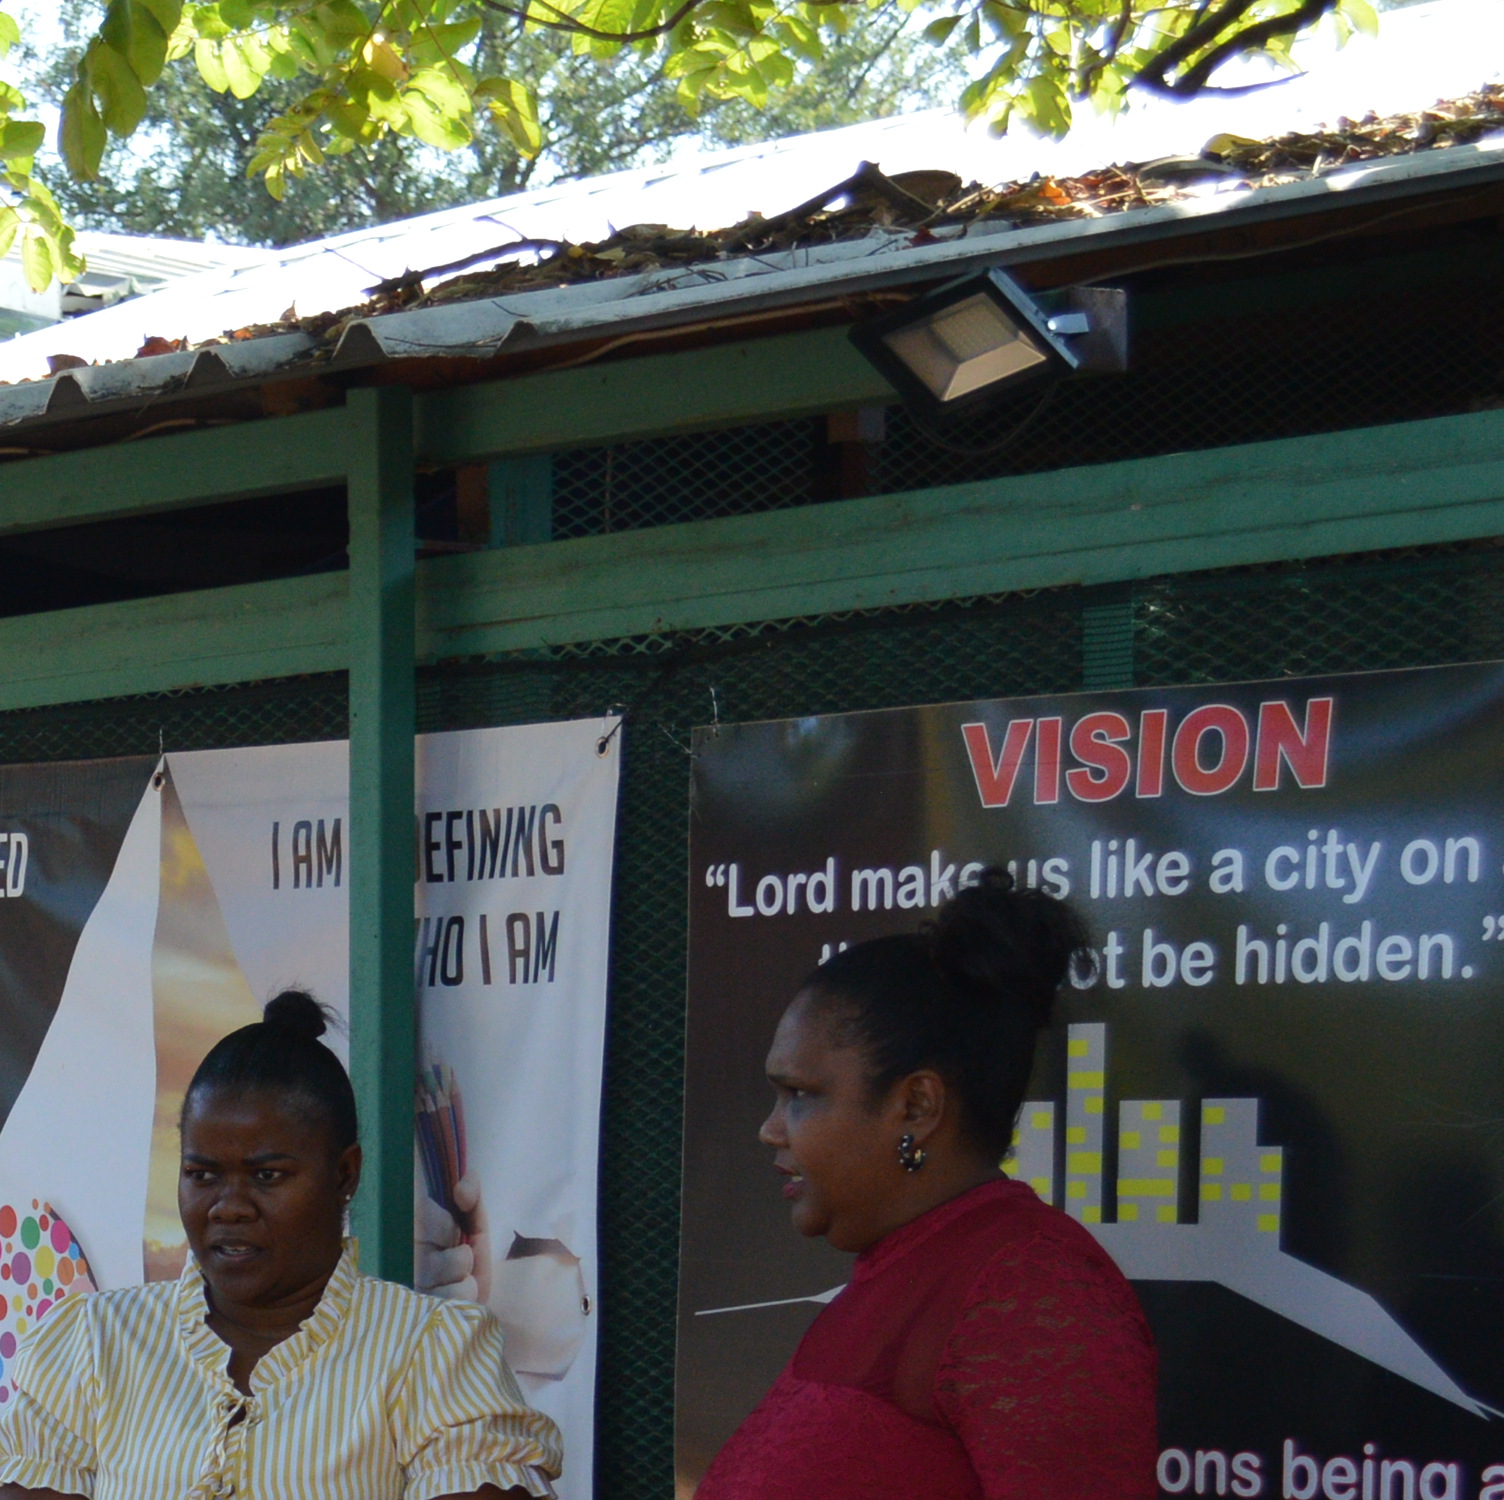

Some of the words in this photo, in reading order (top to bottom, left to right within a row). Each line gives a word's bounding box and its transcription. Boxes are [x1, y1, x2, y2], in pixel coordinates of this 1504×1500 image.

[959, 697, 1334, 809] VISION
[272, 821, 280, 890] I
[293, 817, 342, 889] AM
[705, 856, 835, 918] “Lord
[1090, 837, 1191, 900] like
[1208, 847, 1244, 894] a
[1264, 828, 1381, 904] city
[1400, 836, 1481, 886] on
[414, 914, 466, 987] HO
[479, 914, 492, 985] I
[505, 910, 560, 985] AM
[1142, 927, 1215, 988] be
